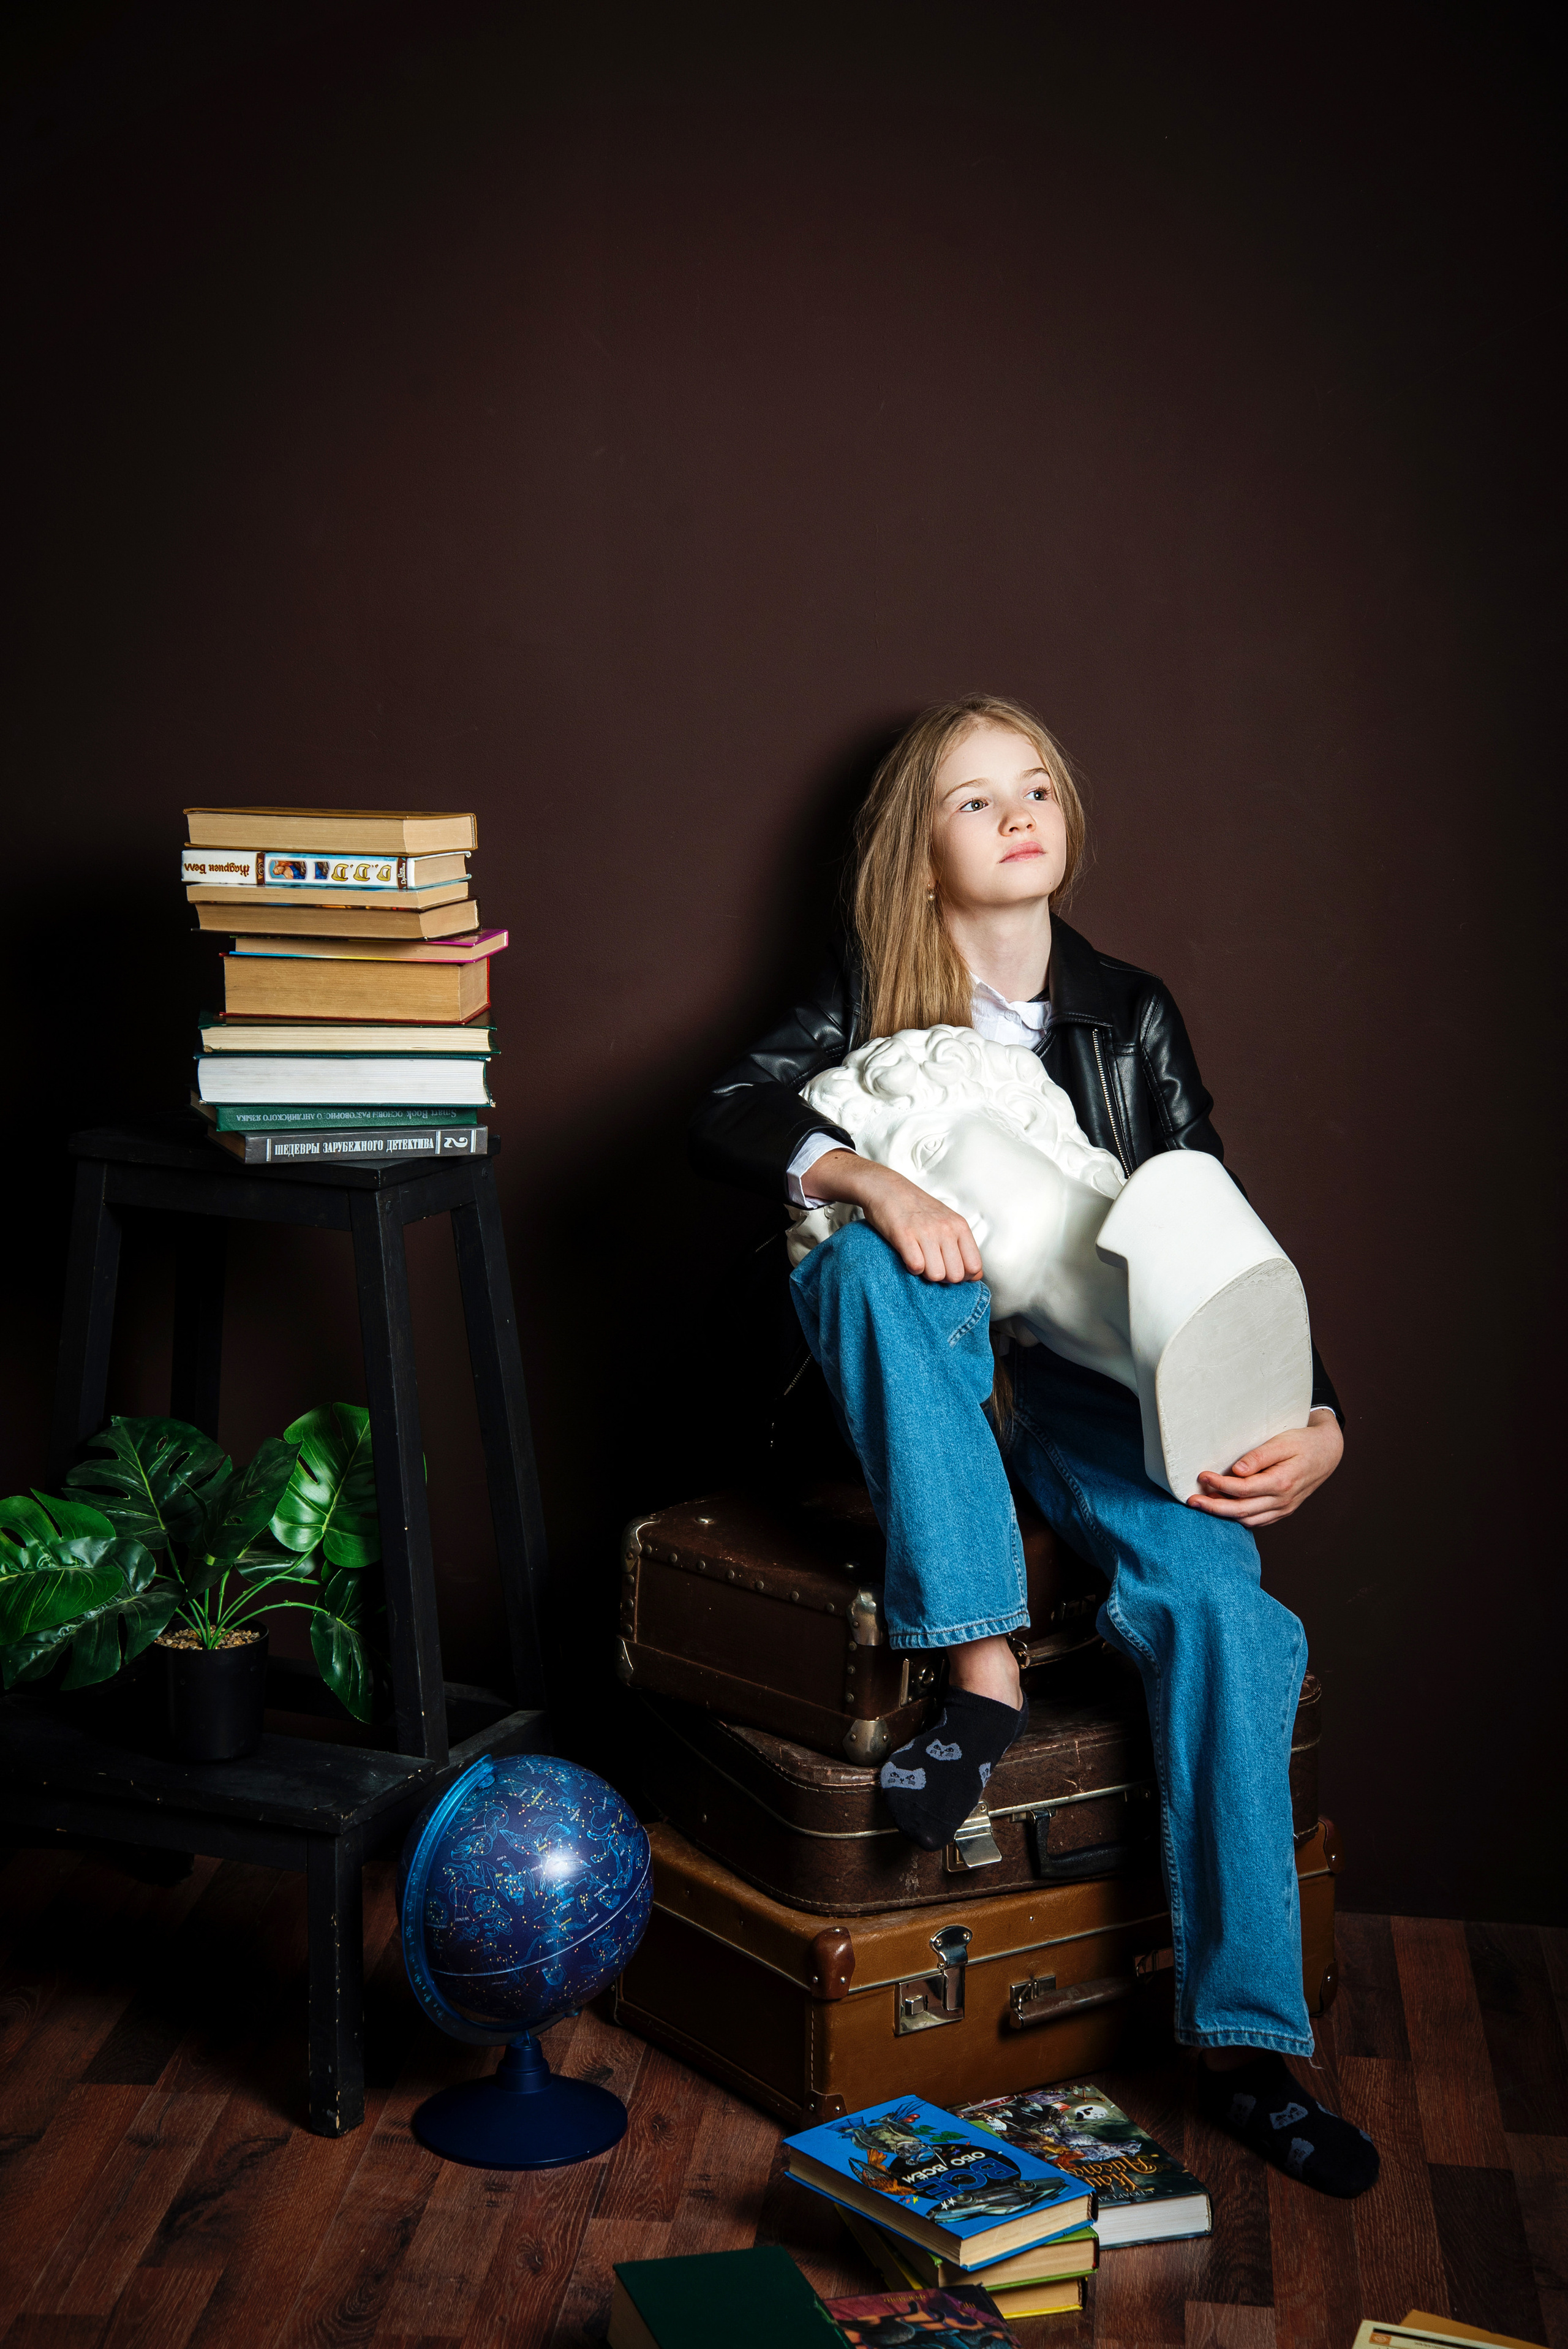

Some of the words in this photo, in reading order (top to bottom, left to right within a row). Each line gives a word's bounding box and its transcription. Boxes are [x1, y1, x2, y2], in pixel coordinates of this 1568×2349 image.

[184, 863, 206, 874] Белл
[208, 862, 250, 877] Жадриен
[262, 1113, 315, 1122] АНГЛИЙСКОГО
[317, 1111, 371, 1120] РАЗОВОРНОО
[406, 1110, 428, 1119] Book
[431, 1109, 457, 1118] Smart
[274, 1141, 320, 1157] ШЕДЕВРЫ
[322, 1140, 384, 1153] ЗАРУБЕЖНОГО
[385, 1138, 435, 1153] ДЕТЕКТИВА
[444, 1137, 469, 1149] 2
[950, 2151, 986, 2167] ОБО
